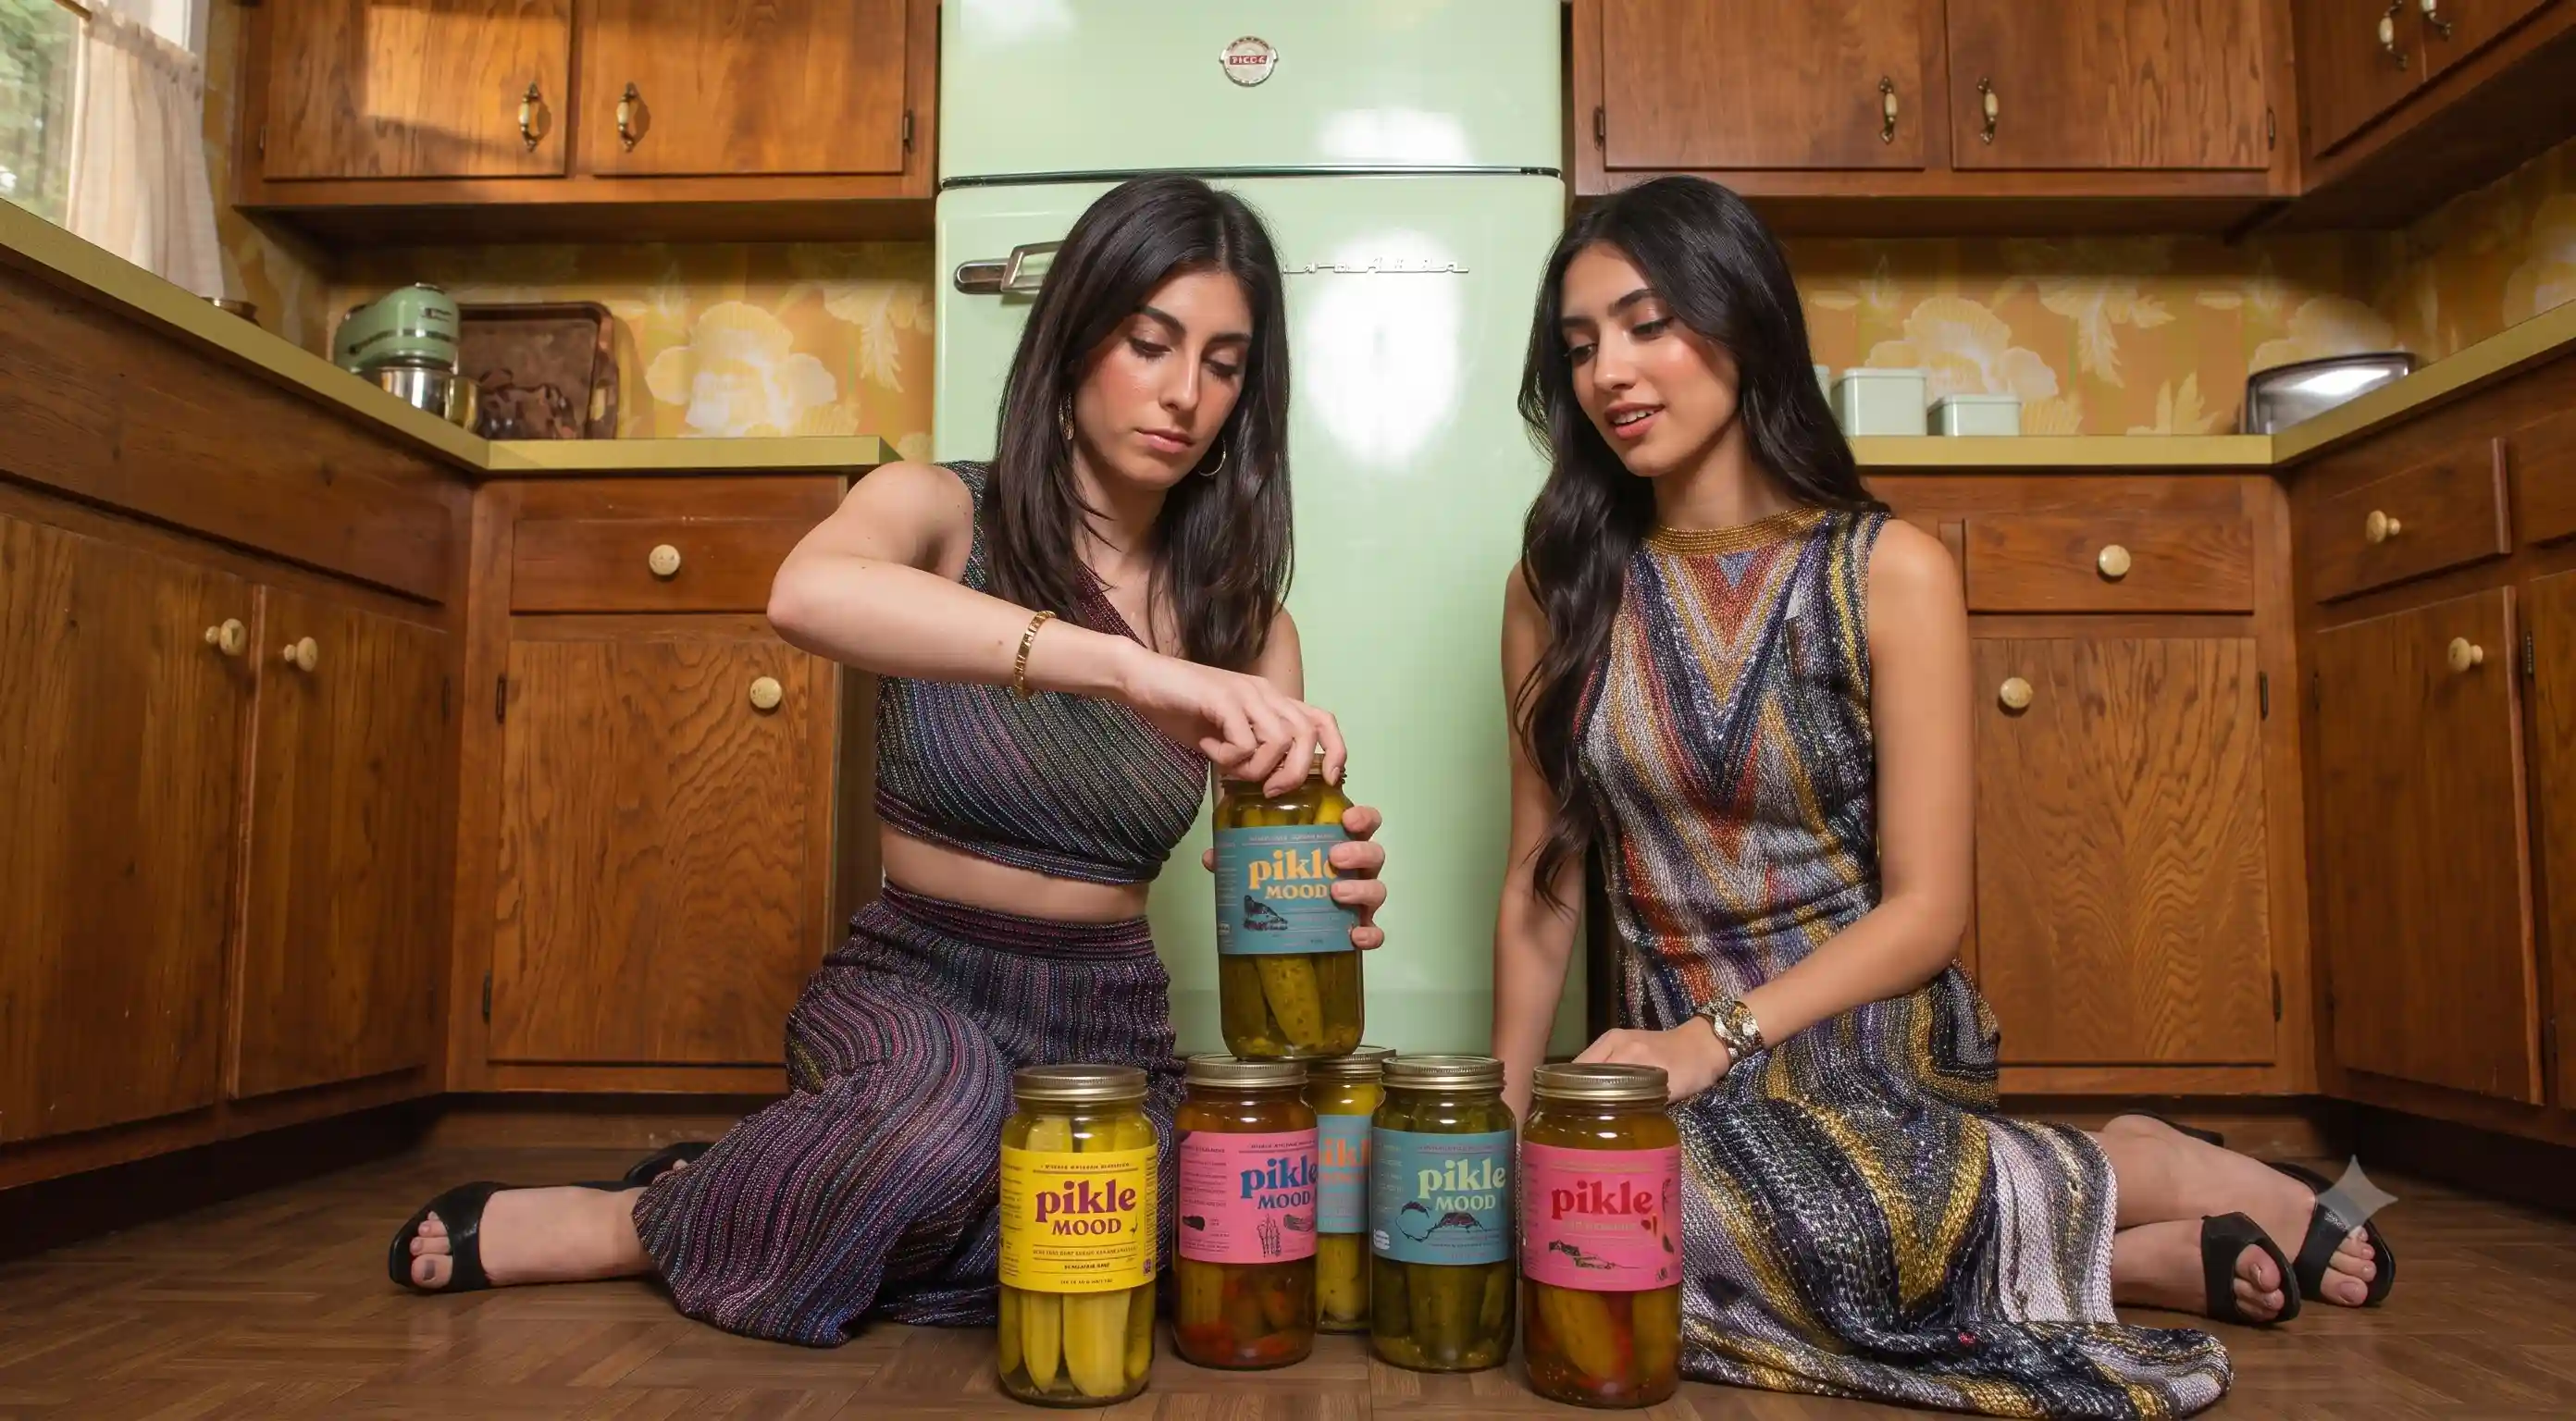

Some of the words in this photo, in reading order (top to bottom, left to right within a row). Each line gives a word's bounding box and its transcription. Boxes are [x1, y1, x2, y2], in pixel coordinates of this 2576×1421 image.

[1265, 883, 1328, 899] MOOD
[1323, 1138, 1370, 1168] ikl
[1240, 1155, 1319, 1199] pikle
[1418, 1157, 1506, 1200] pikle
[1034, 1179, 1137, 1223] pikle
[1257, 1191, 1310, 1209] MOOD
[1435, 1194, 1496, 1212] MOOD
[1551, 1180, 1653, 1220] pikle
[1052, 1217, 1121, 1235] MOOD
